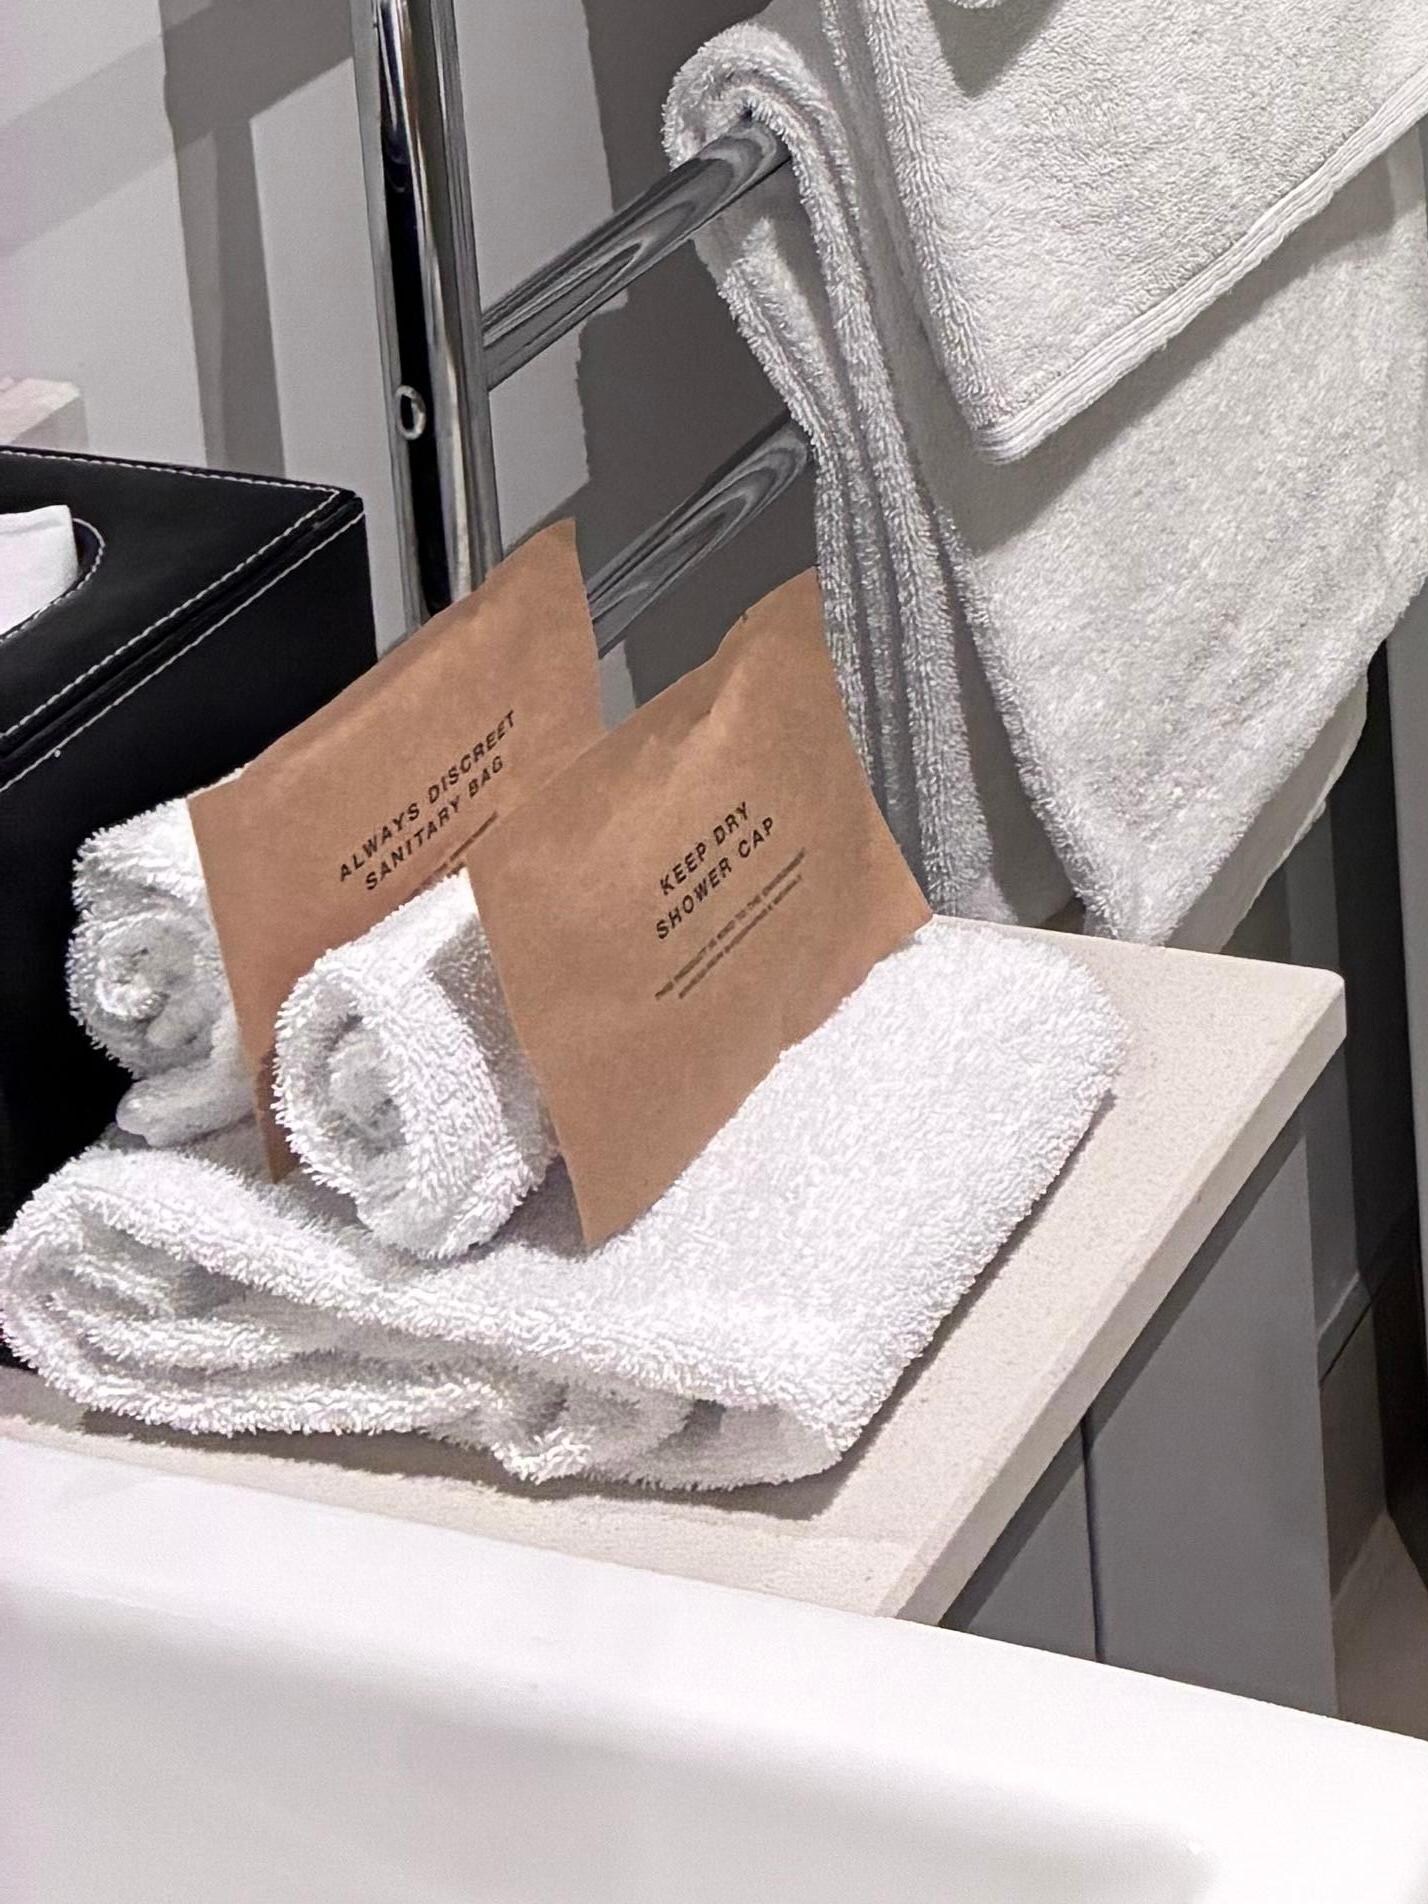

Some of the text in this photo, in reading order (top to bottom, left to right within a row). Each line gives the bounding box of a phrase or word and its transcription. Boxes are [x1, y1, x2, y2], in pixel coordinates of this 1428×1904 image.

[339, 801, 421, 882] ALWAYS
[427, 709, 516, 804] DISCREET
[365, 798, 461, 891] SANITARY
[469, 755, 505, 798] BAG
[660, 801, 750, 896] KEEP DRY
[656, 857, 732, 940] SHOWER
[738, 816, 775, 859] CAP
